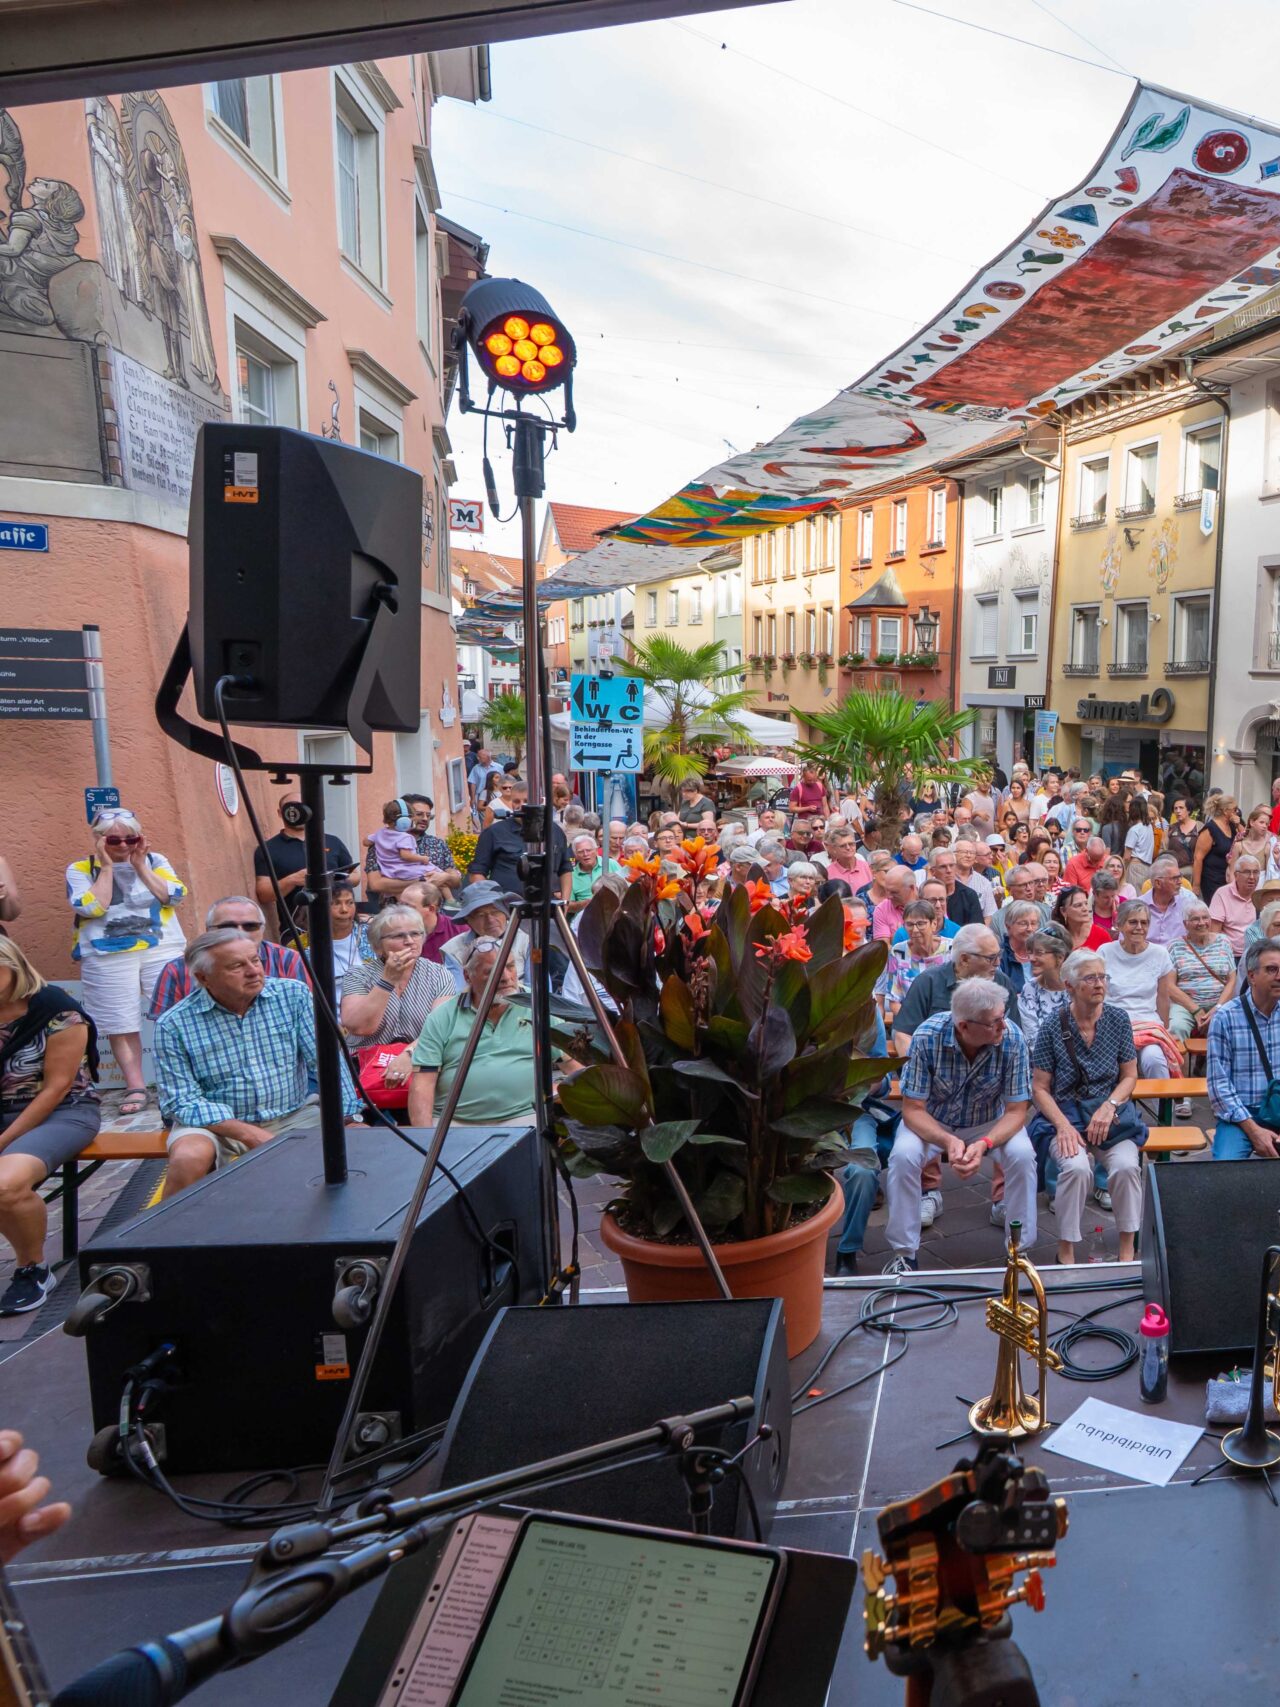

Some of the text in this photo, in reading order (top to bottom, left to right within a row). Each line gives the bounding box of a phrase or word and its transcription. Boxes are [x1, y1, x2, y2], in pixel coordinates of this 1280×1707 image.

[456, 509, 474, 522] M
[574, 741, 613, 749] Korngasse
[87, 793, 95, 801] S
